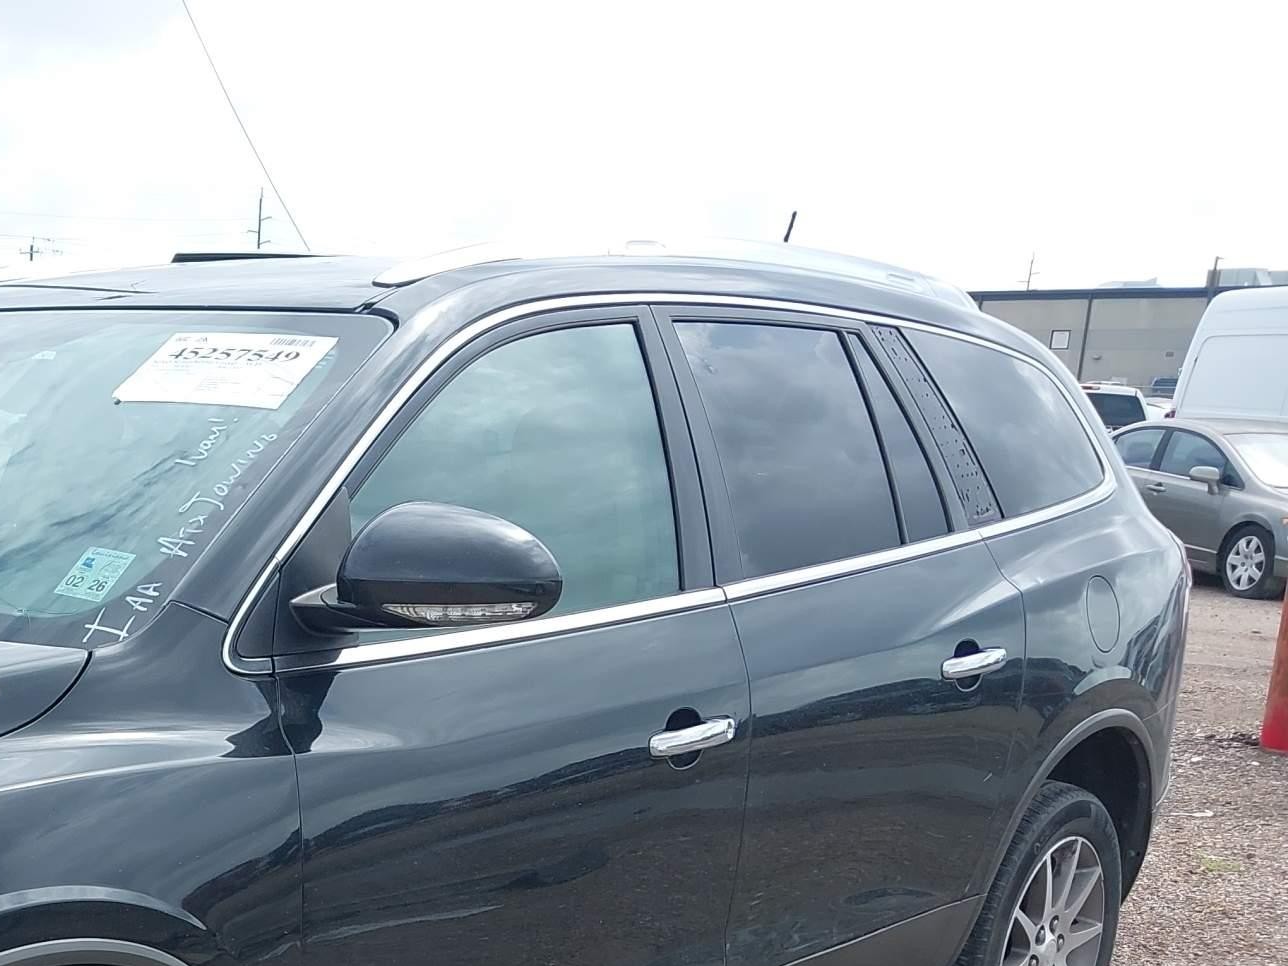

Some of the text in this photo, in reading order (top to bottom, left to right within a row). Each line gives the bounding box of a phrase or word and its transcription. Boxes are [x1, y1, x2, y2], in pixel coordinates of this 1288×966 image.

[168, 346, 301, 363] 45257549
[64, 574, 108, 593] 02 26
